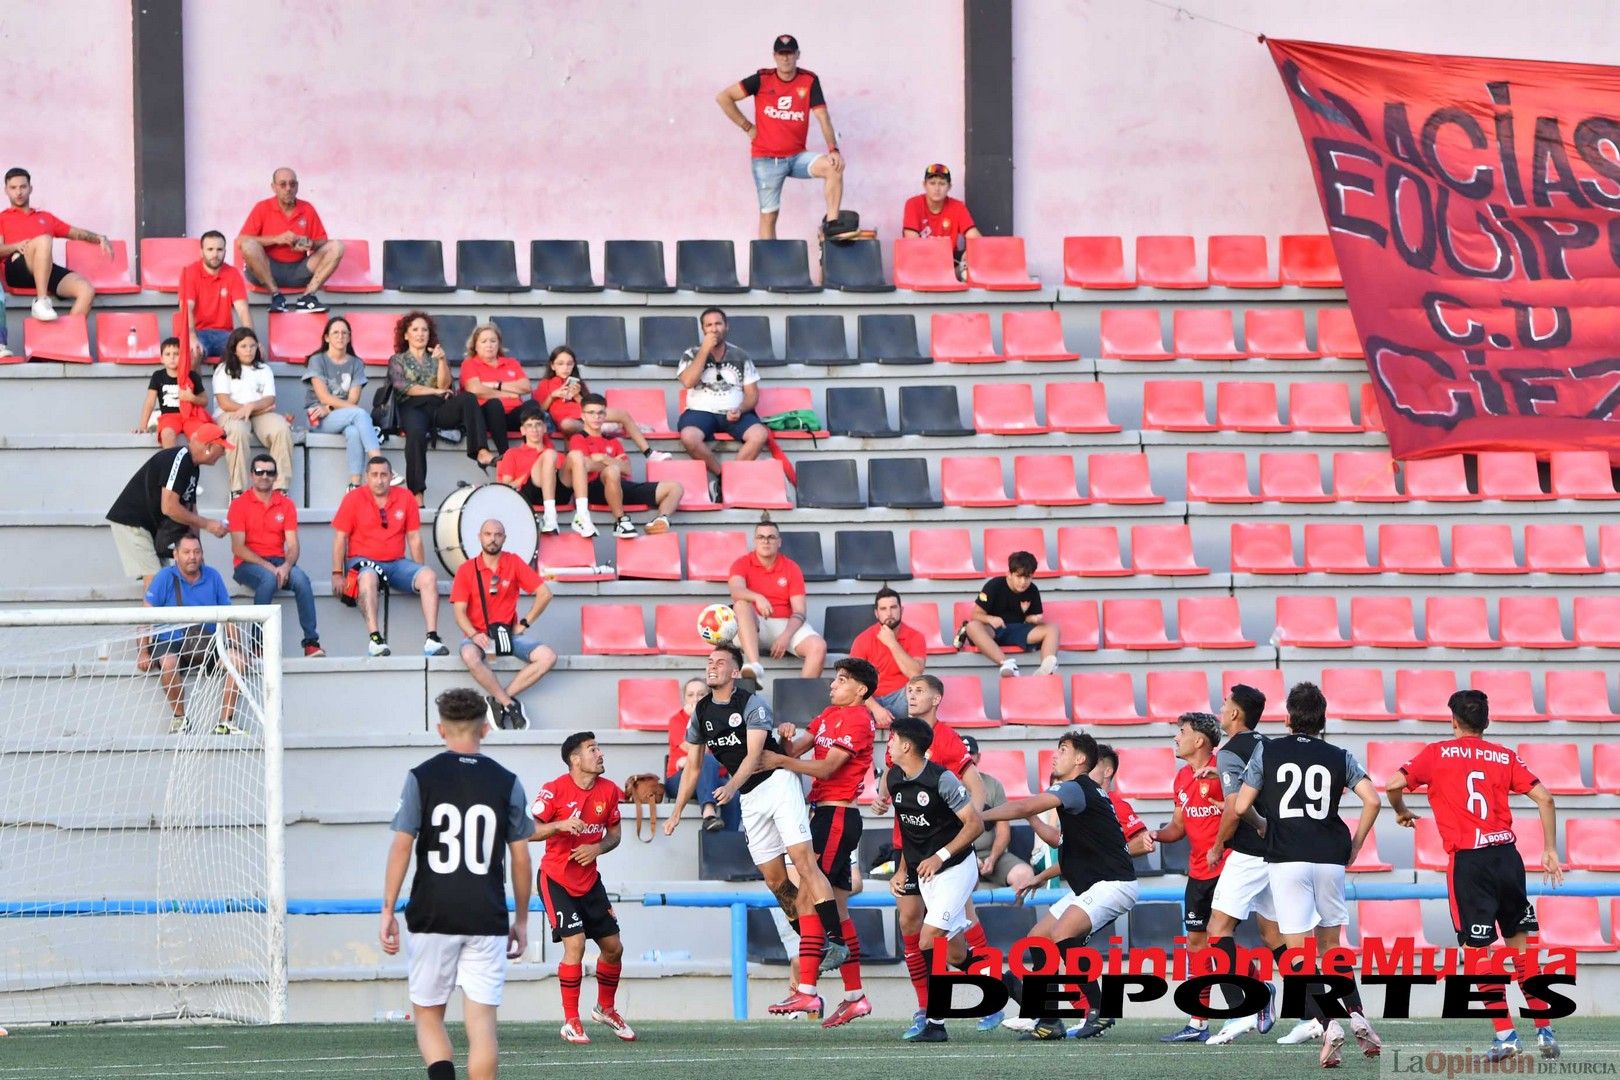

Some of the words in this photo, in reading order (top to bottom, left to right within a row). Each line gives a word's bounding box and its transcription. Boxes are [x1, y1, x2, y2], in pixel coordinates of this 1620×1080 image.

[1441, 746, 1472, 759] XAVI
[1475, 748, 1510, 765] PONS
[1276, 762, 1332, 820] 29
[1466, 770, 1488, 821] 6
[427, 802, 497, 876] 30
